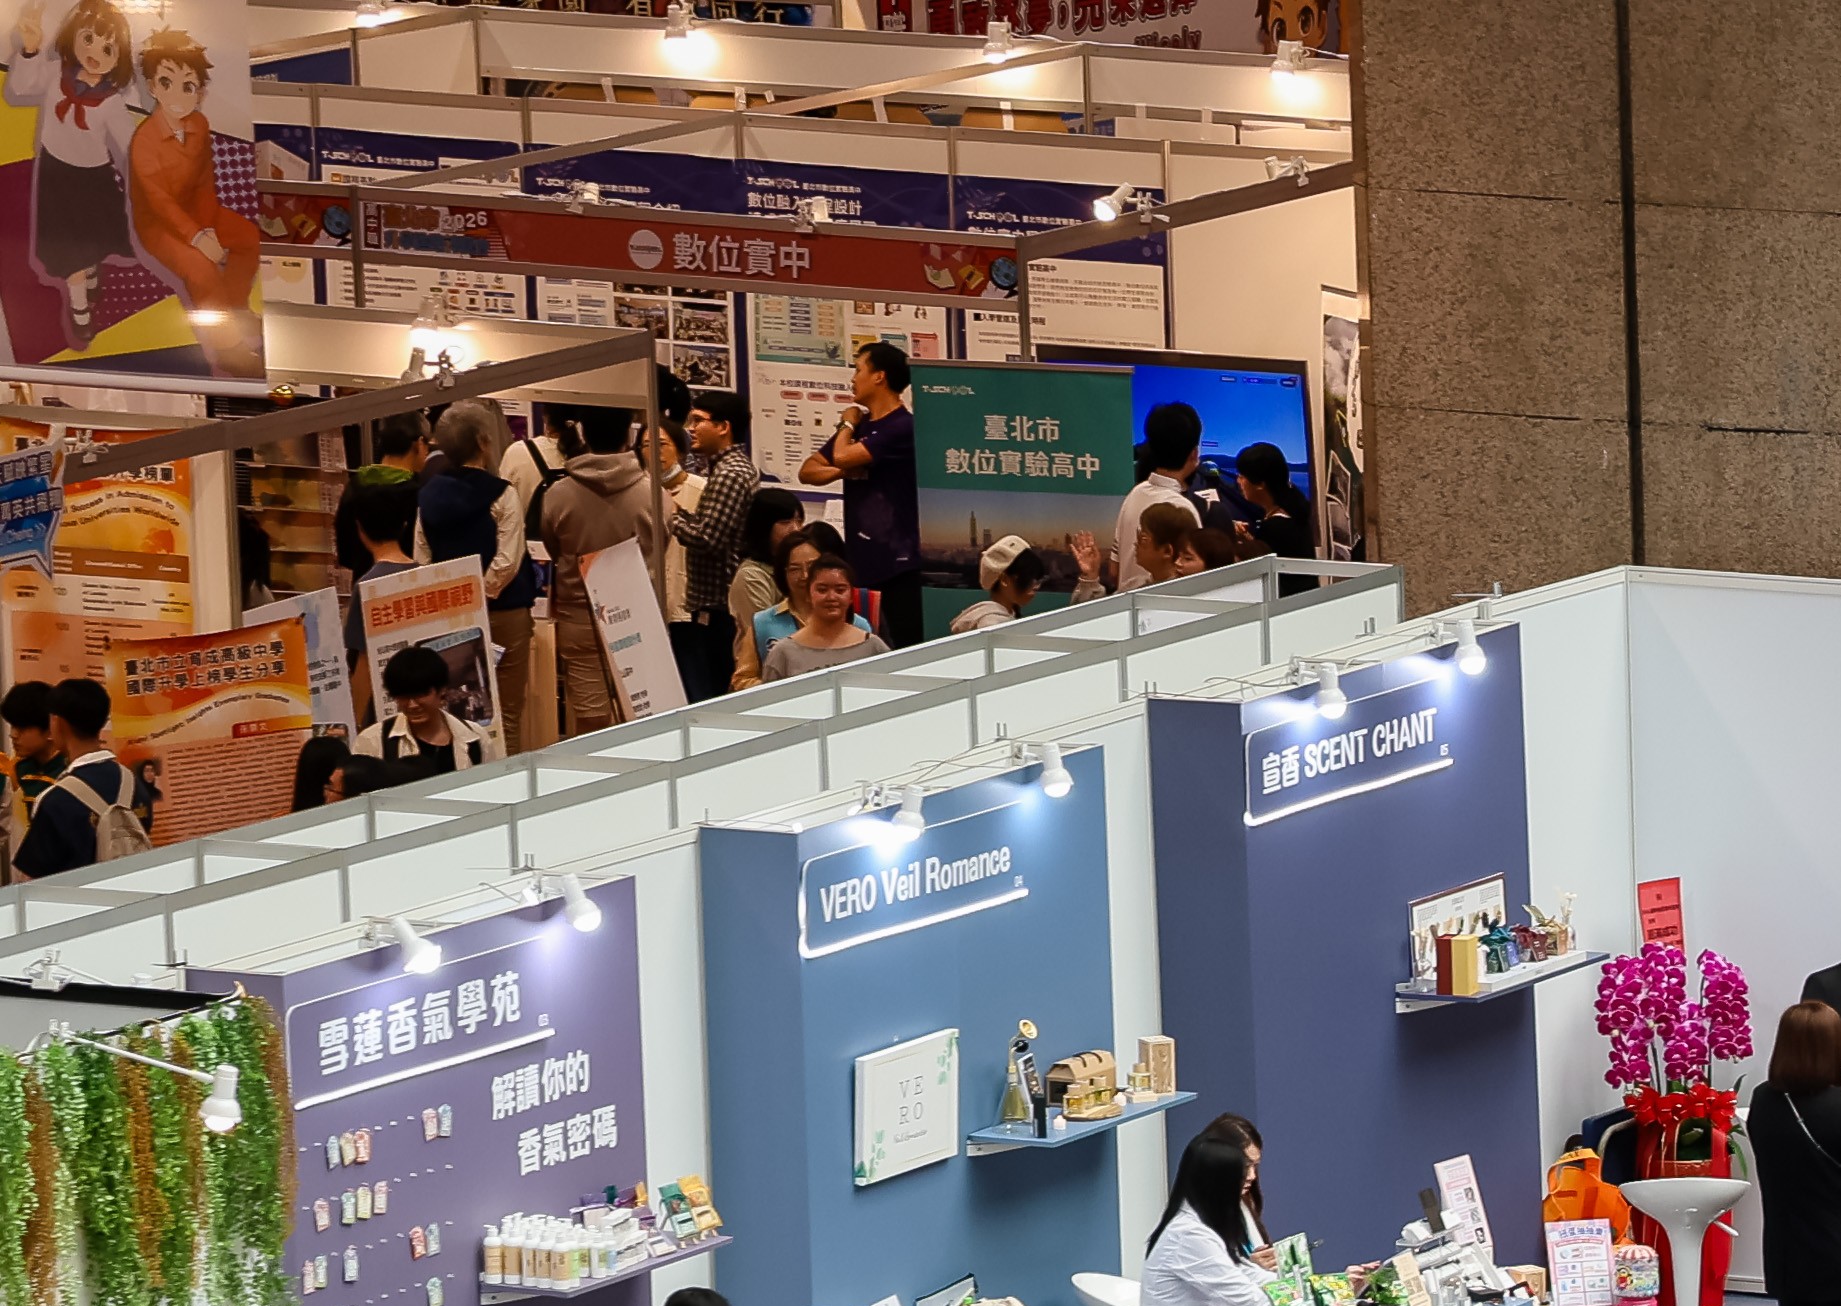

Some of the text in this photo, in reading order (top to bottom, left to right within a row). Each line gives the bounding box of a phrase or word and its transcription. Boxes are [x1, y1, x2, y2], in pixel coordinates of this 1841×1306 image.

[672, 230, 811, 280] 數位實中
[945, 447, 1101, 480] 數位實驗高中
[983, 414, 1061, 443] 臺北市
[1261, 707, 1438, 795] 宣香 SCENT CHANT
[819, 846, 1012, 923] VERO Veil Romance
[318, 969, 522, 1077] 雪蓮香氣學苑
[491, 1049, 591, 1121] 解讀你的
[517, 1104, 619, 1176] 香氣密碼
